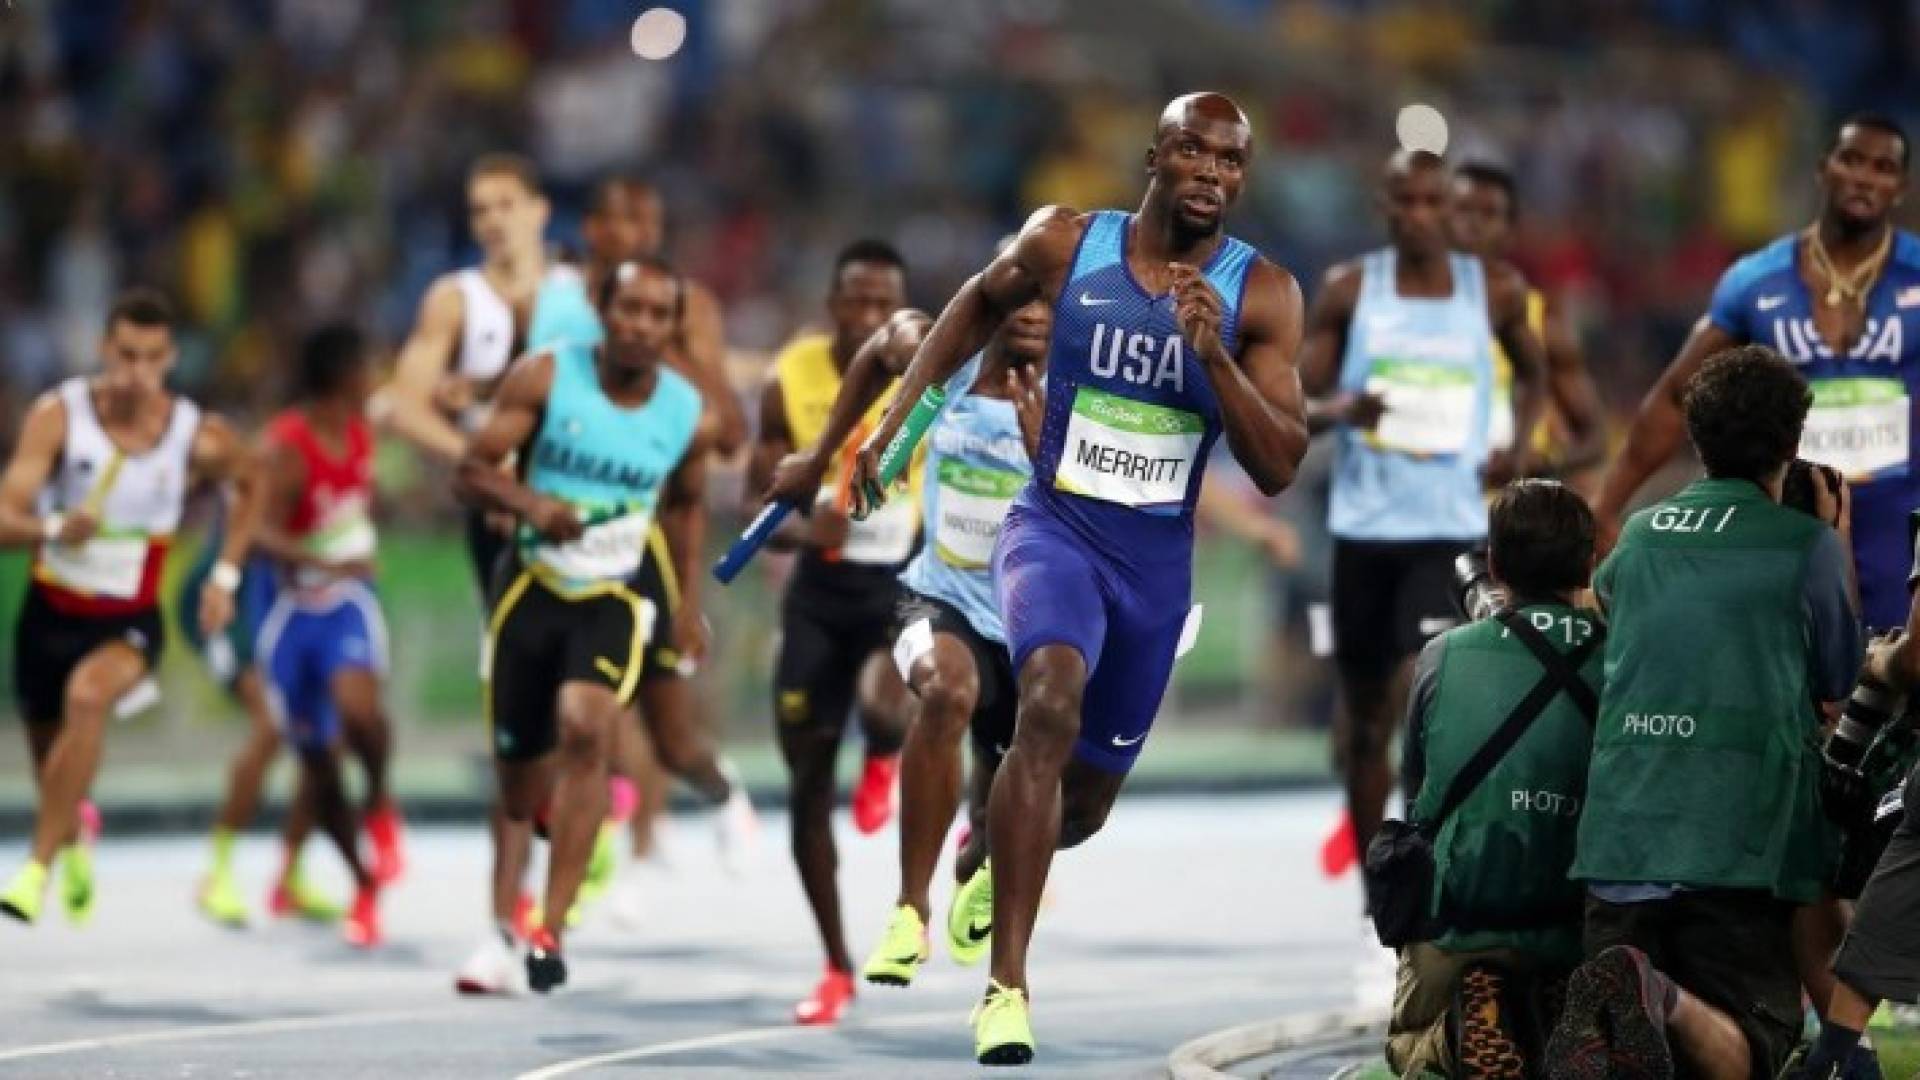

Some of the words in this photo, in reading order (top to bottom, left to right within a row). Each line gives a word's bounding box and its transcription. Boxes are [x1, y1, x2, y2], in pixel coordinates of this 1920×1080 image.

[1089, 322, 1185, 393] USA
[1077, 438, 1186, 482] MERRITT
[1623, 712, 1697, 738] PHOTO
